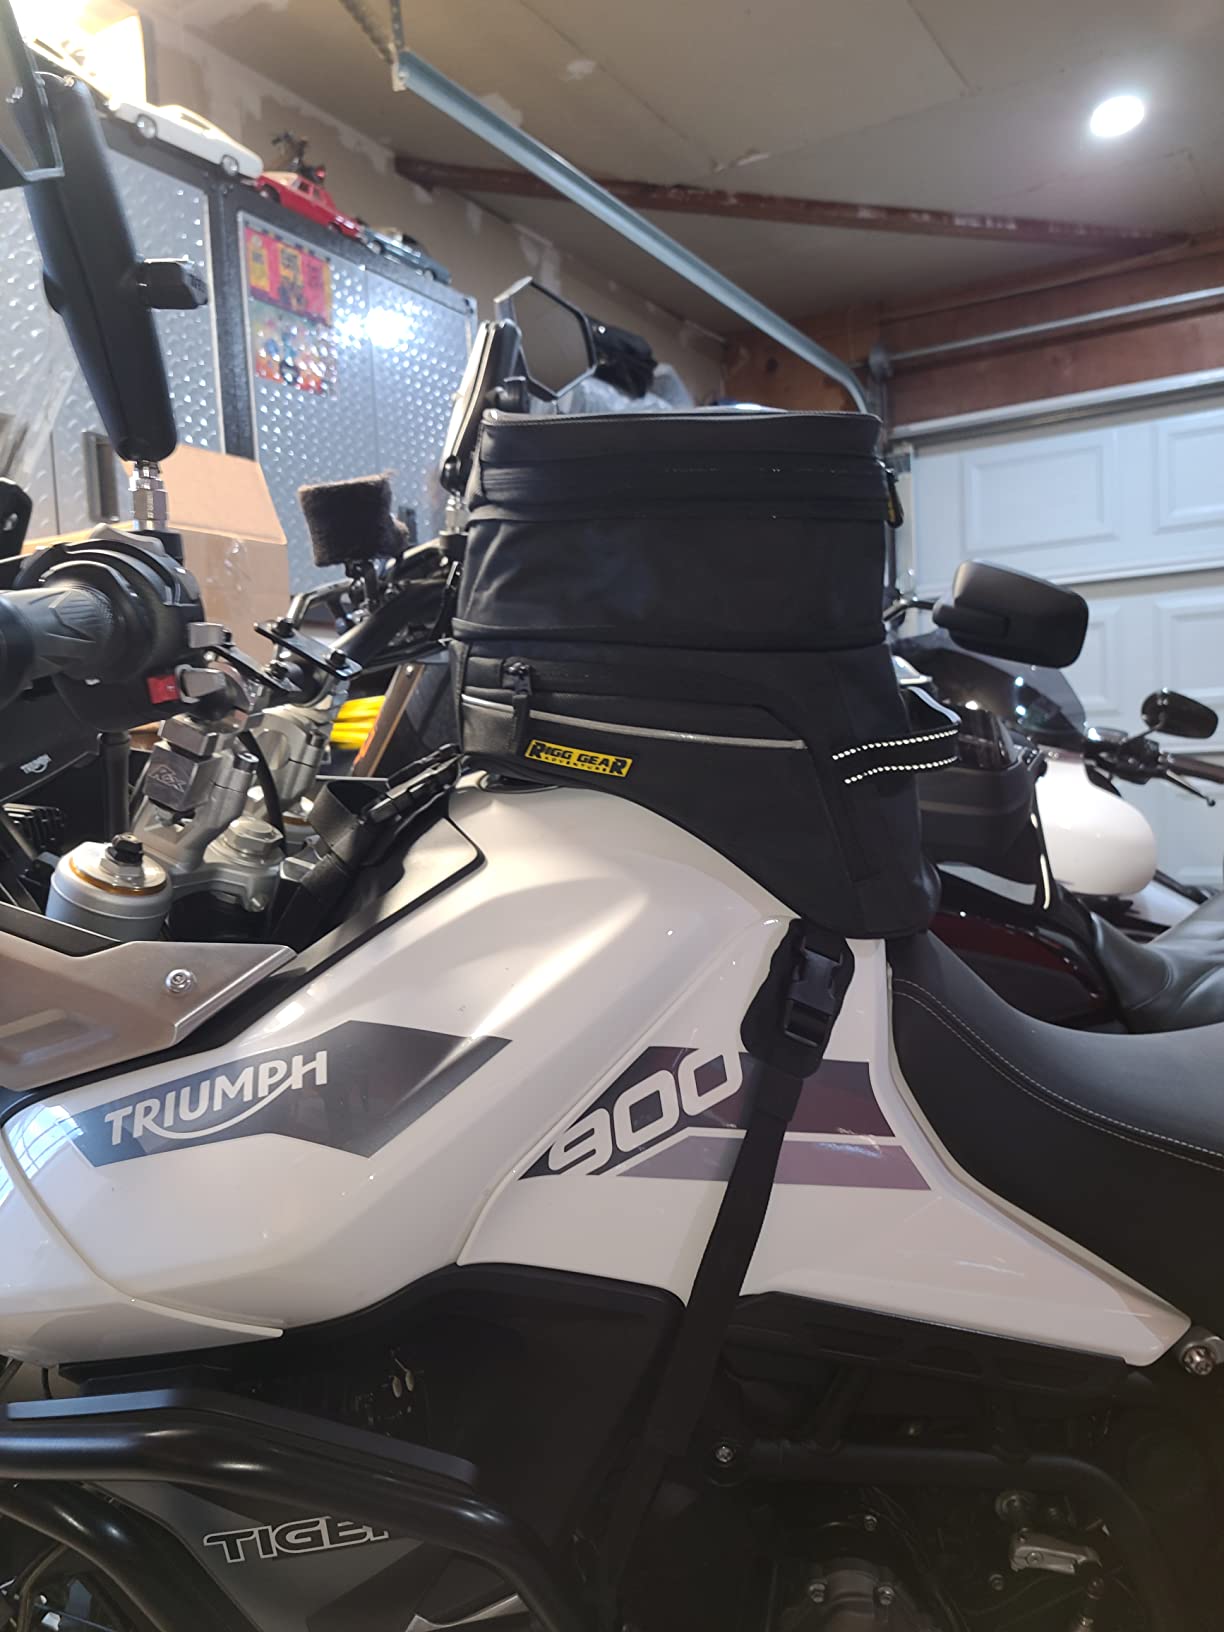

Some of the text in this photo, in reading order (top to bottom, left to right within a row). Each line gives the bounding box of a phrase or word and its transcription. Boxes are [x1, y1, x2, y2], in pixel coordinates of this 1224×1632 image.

[529, 742, 628, 775] RIGG GEAR
[104, 1050, 328, 1146] TRIUMPH
[548, 1043, 744, 1176] 900
